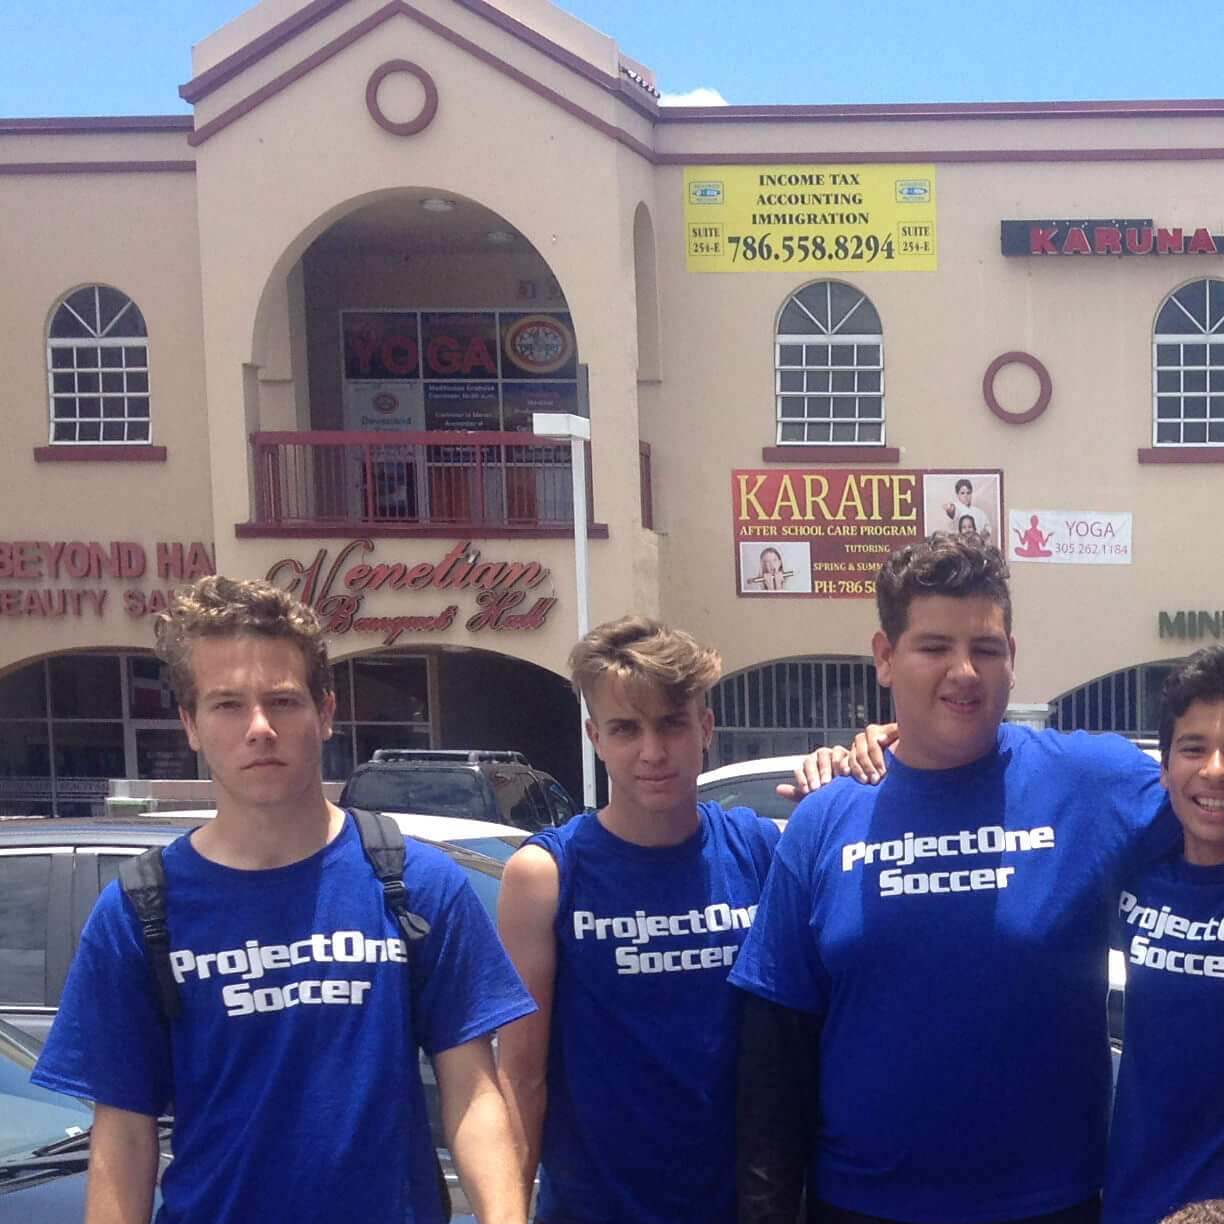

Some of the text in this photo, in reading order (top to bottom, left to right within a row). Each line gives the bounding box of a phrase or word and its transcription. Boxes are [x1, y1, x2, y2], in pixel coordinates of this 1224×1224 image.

[759, 174, 860, 186] INCOME TAX
[756, 194, 863, 206] ACCOUNTING
[751, 213, 869, 225] IMMIGRATION
[902, 226, 930, 237] SUITE
[692, 228, 720, 238] SUITE
[1029, 227, 1218, 254] KARUNA
[727, 232, 896, 263] 786.558.8294
[353, 335, 498, 375] YOGA
[736, 474, 917, 521] KARATE
[740, 525, 917, 536] AFTER SCHOOL CARE PROGRAM
[1065, 520, 1115, 538] YOGA
[0, 541, 217, 579] BEYOND HA
[844, 544, 891, 553] TUTORING
[1055, 543, 1074, 554] 305
[265, 538, 547, 606] Venetian
[813, 562, 846, 571] SPRING
[814, 580, 837, 593] PH:
[838, 580, 863, 593] 786
[316, 590, 559, 646] Banquet Hall
[841, 825, 1056, 872] ProjectOne
[878, 866, 1016, 897] Soccer
[169, 930, 408, 984] ProjectOne
[615, 944, 739, 975] Soccer
[221, 980, 372, 1017] Soccer
